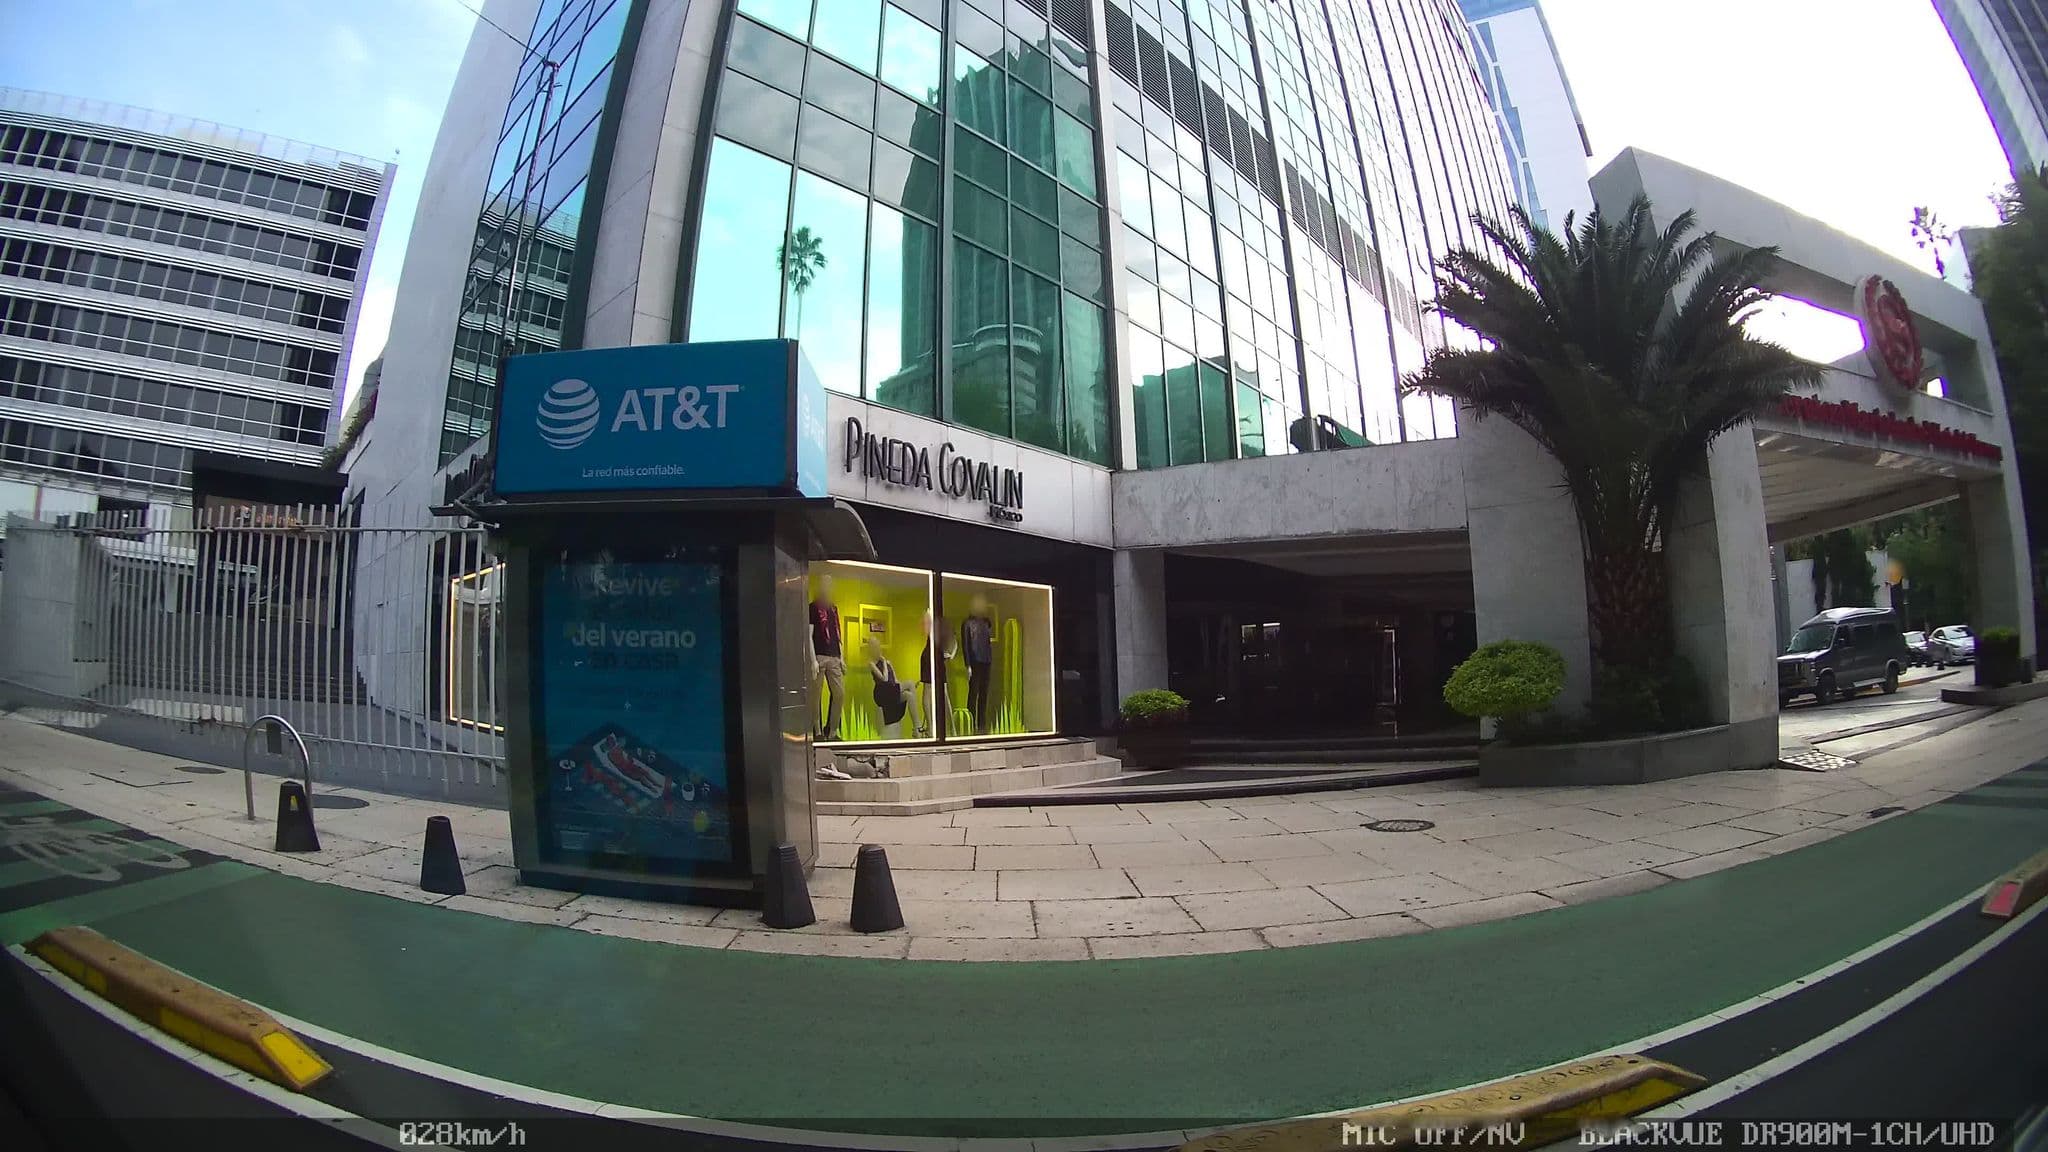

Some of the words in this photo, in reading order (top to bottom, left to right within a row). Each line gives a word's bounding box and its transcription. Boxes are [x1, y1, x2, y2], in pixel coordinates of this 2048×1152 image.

[611, 384, 740, 432] AT&T
[582, 466, 594, 478] La
[595, 466, 612, 477] red
[845, 416, 934, 492] PINEDA
[938, 442, 1024, 510] COVALIN
[572, 622, 608, 648] del
[611, 628, 697, 649] verano
